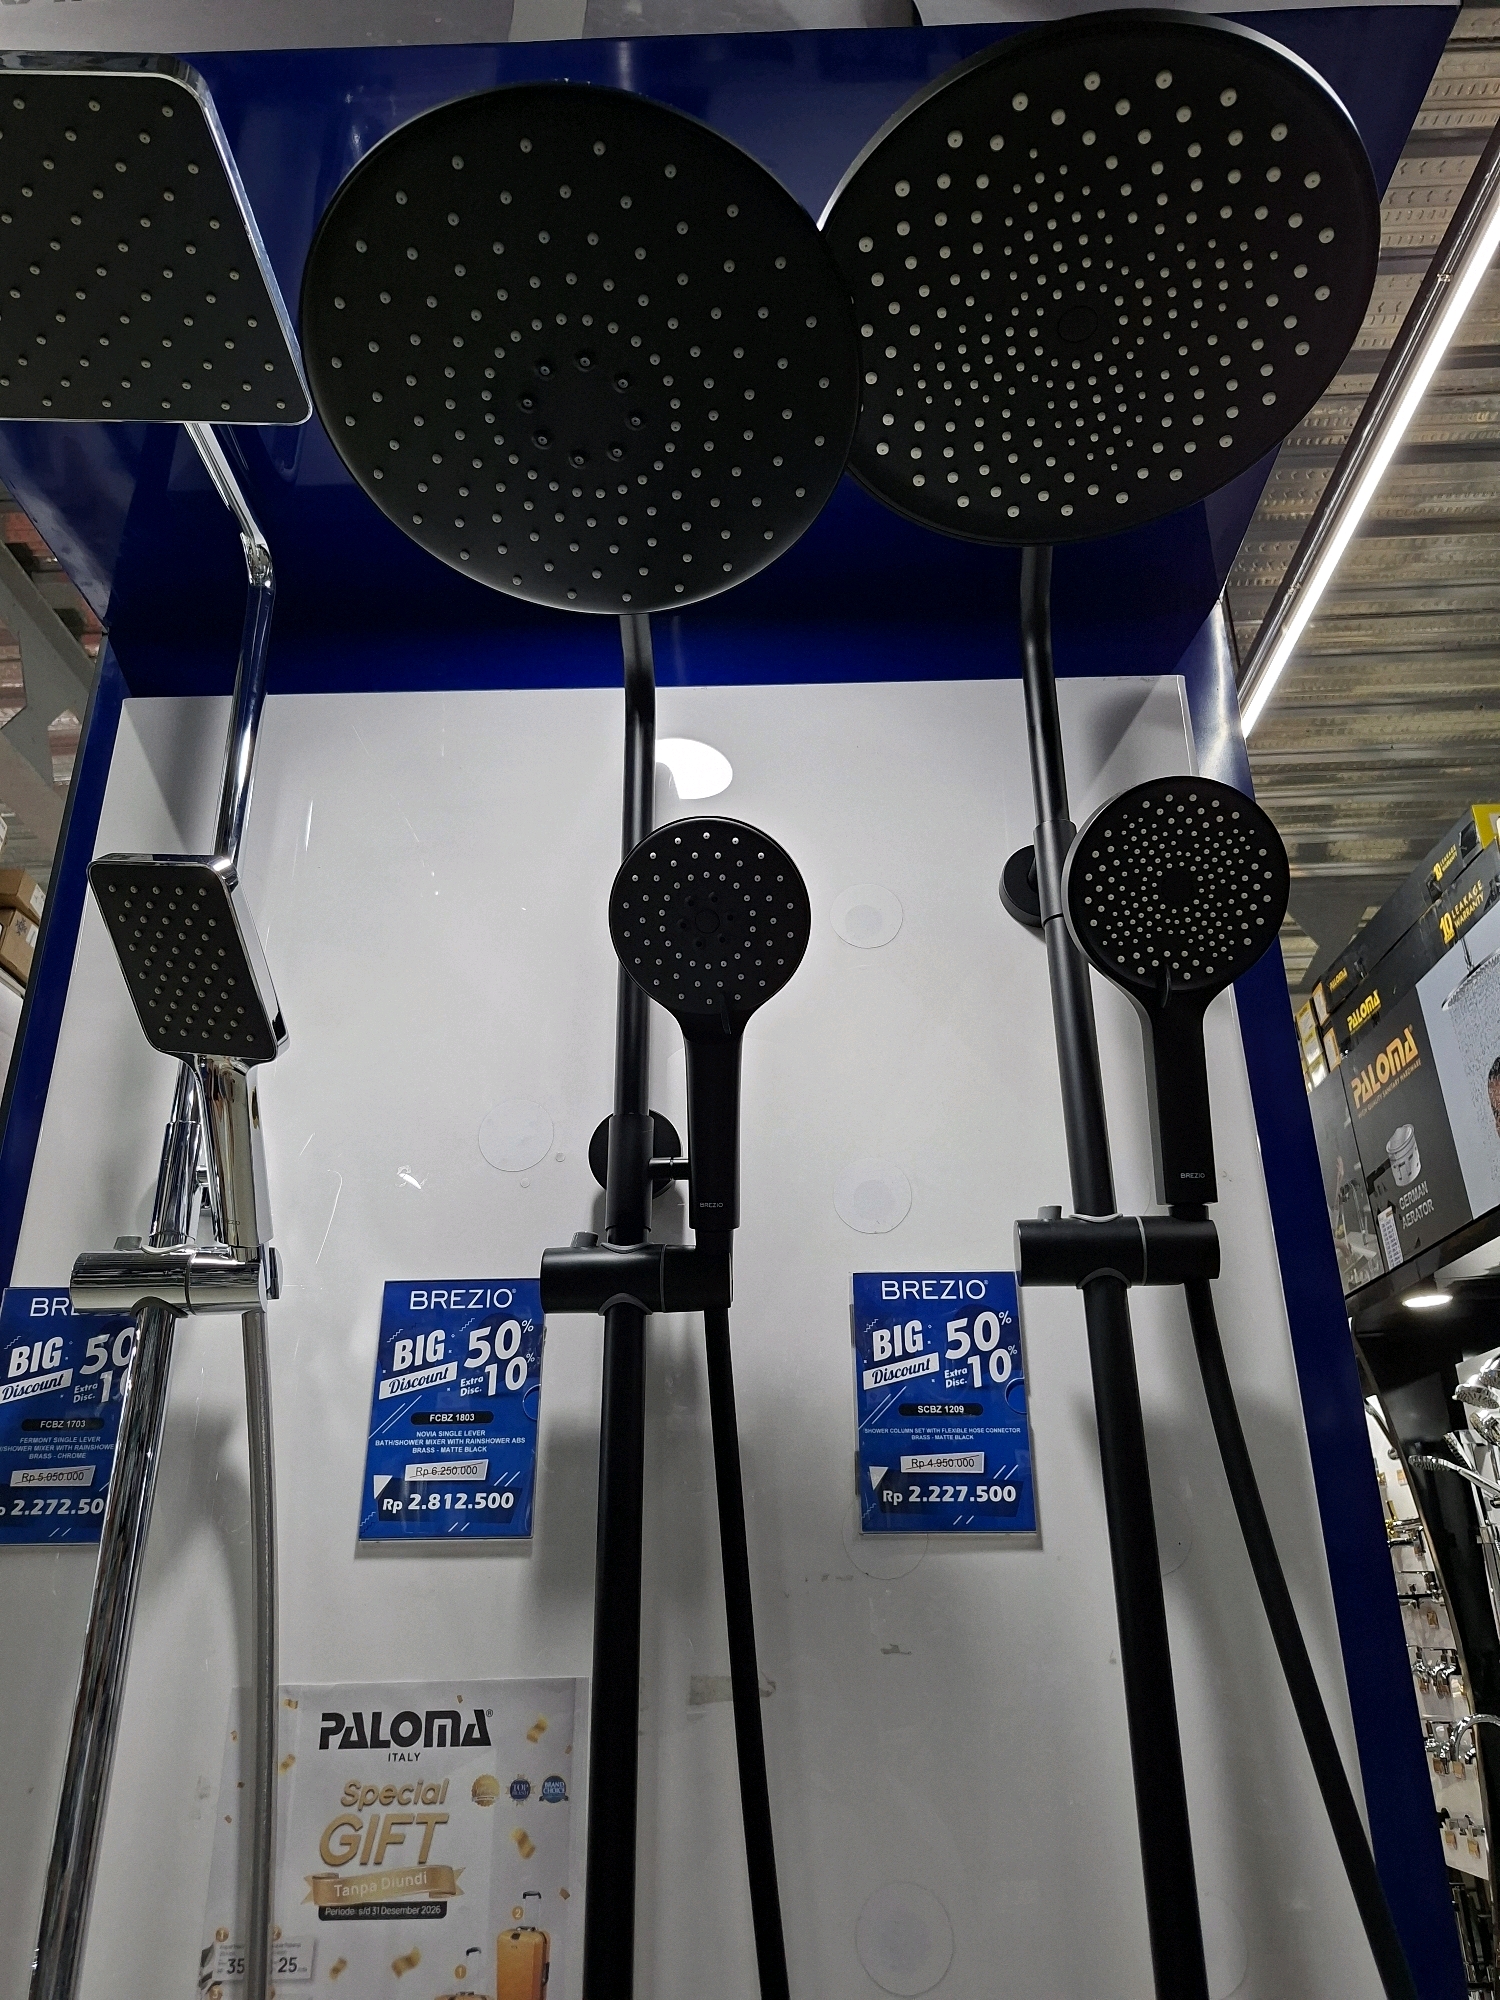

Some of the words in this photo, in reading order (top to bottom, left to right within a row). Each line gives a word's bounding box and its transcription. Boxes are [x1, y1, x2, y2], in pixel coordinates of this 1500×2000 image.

[1451, 879, 1483, 918] LEAKAGE
[1453, 890, 1484, 929] WARRANTY
[1346, 988, 1381, 1031] PALOMA
[1350, 1027, 1419, 1109] PALOMA
[1398, 1180, 1429, 1211] GERMAN
[1401, 1198, 1435, 1230] AERATOR
[463, 1318, 534, 1368] 50%
[872, 1319, 924, 1362] BIG
[945, 1310, 1012, 1360] 50%
[8, 1336, 64, 1379] BIG
[392, 1329, 446, 1372] BIG
[484, 1352, 535, 1396] 10%
[871, 1357, 931, 1385] Discount
[944, 1366, 968, 1379] Extra
[967, 1344, 1018, 1388] 10%
[2, 1374, 64, 1401] Discount
[74, 1383, 98, 1394] Extra
[388, 1366, 450, 1394] Discount
[460, 1375, 484, 1388] Extra
[945, 1378, 968, 1389] Disc.
[73, 1393, 96, 1404] Disc.
[460, 1387, 482, 1397] Disc.
[429, 1413, 453, 1422] FCBZ
[455, 1413, 475, 1422] 1803
[917, 1405, 943, 1414] SCBZ
[944, 1405, 965, 1413] 1209
[40, 1420, 64, 1428] FCBZ
[66, 1420, 86, 1428] 1703
[416, 1430, 437, 1438] NOVIA
[465, 1437, 510, 1445] RAINSHOWER
[415, 1466, 429, 1477] Rp
[431, 1465, 478, 1476] 6.250.000
[911, 1458, 925, 1469] Rp
[927, 1457, 975, 1468] 4.950.000
[21, 1472, 35, 1483] Rp
[382, 1498, 403, 1514] Rp
[407, 1492, 515, 1511] 2.812.500
[882, 1490, 903, 1505] Rp
[908, 1485, 1017, 1502] 2.227.500
[387, 1752, 421, 1762] ITALY
[341, 1778, 450, 1812] Special
[513, 1783, 529, 1791] TOP
[319, 1812, 450, 1867] GIFT
[333, 1880, 377, 1898] Tanpa
[381, 1871, 428, 1890] Diundi
[371, 1907, 380, 1915] 31
[380, 1905, 420, 1915] Desember
[420, 1905, 441, 1914] 2026
[227, 1958, 245, 1974] 35
[278, 1956, 298, 1973] 25
